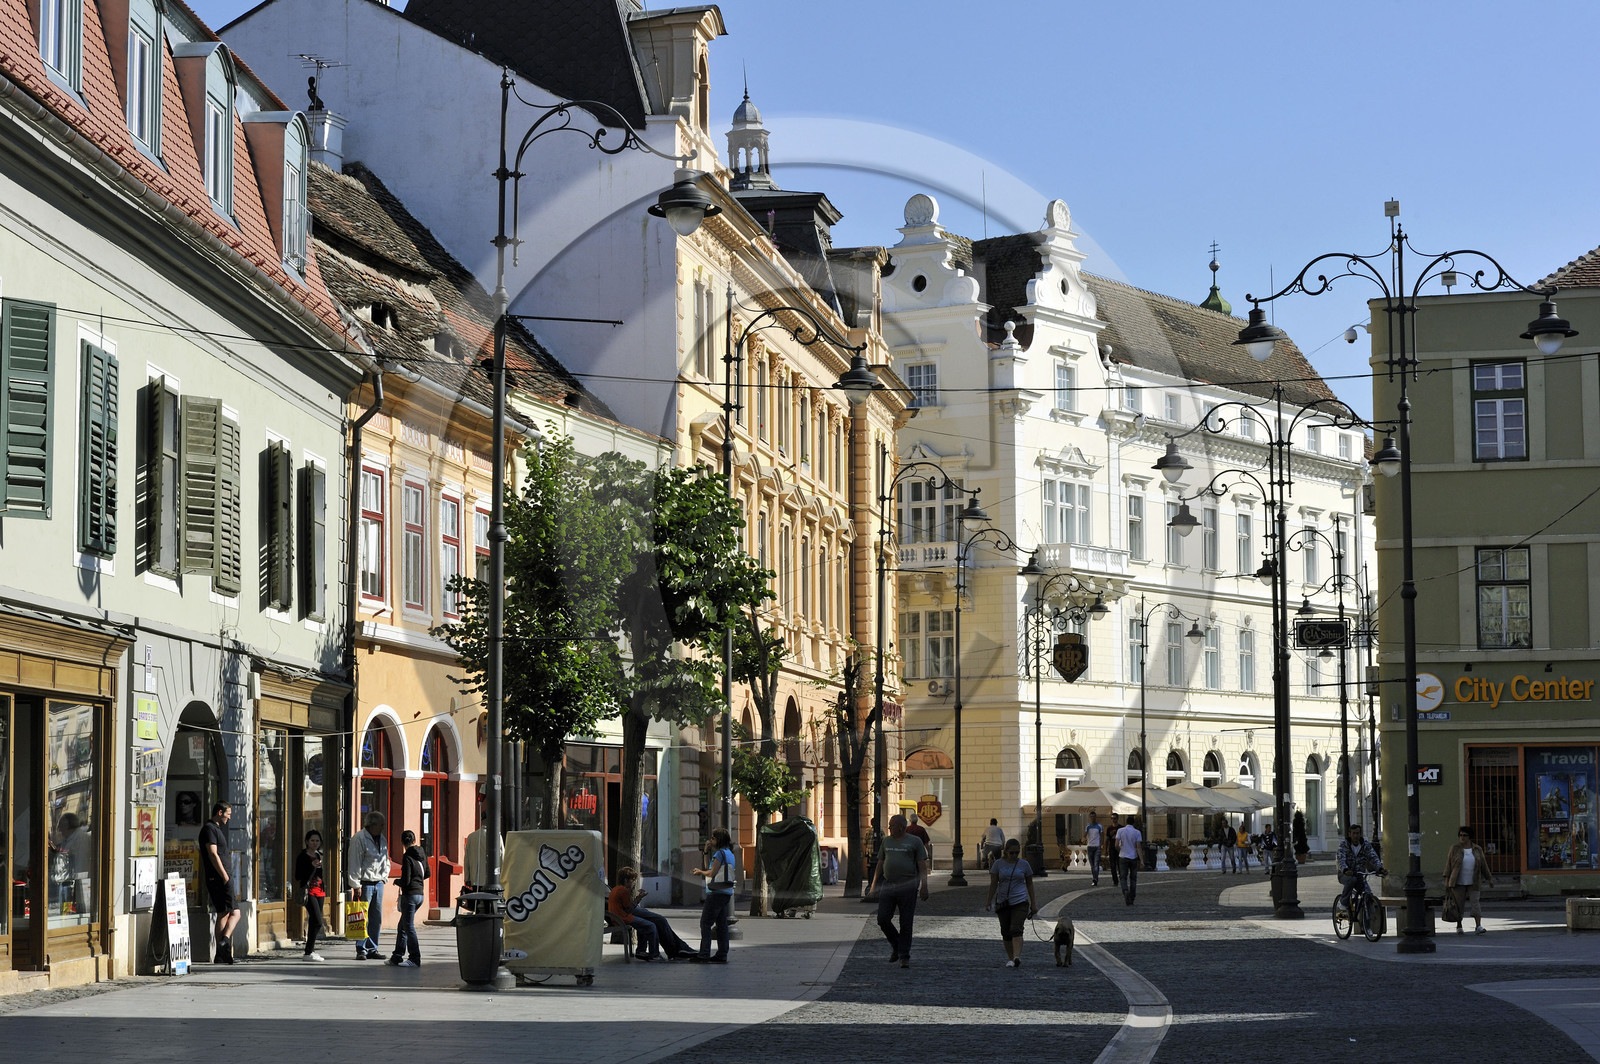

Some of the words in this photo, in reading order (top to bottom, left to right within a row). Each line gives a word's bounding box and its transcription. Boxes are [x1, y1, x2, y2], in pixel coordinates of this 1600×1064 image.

[1454, 676, 1504, 709] City
[1511, 675, 1595, 700] Center
[505, 869, 557, 922] Cool
[348, 912, 365, 923] BILLA
[171, 937, 190, 962] outlet
